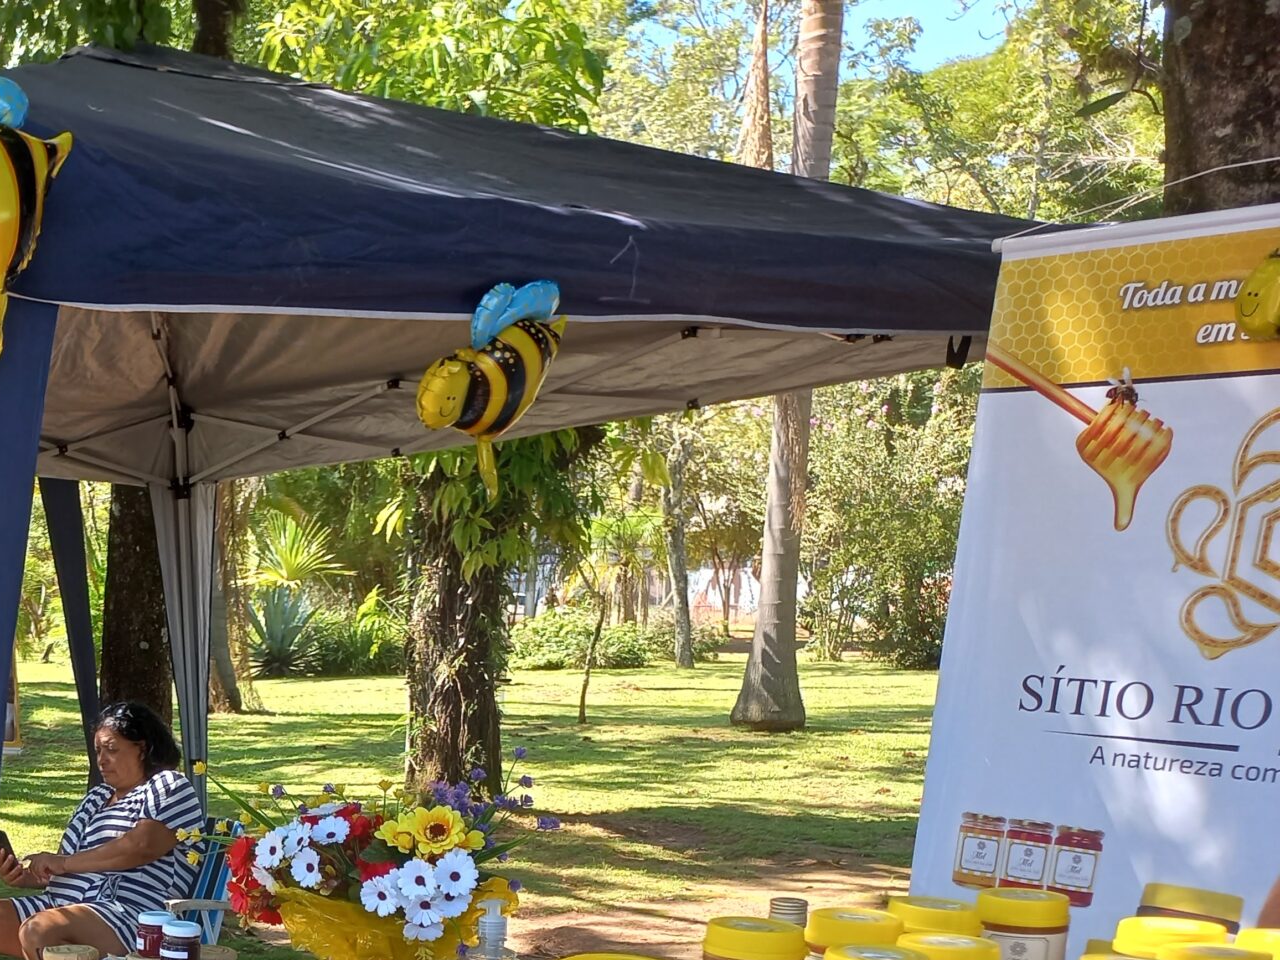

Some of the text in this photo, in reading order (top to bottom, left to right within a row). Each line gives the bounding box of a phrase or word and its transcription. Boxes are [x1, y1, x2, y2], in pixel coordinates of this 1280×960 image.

[1119, 279, 1245, 310] Toda a m
[1196, 322, 1236, 344] em
[1018, 664, 1273, 730] SÍTIO RIO
[1088, 745, 1106, 766] A
[1111, 751, 1223, 778] natureza
